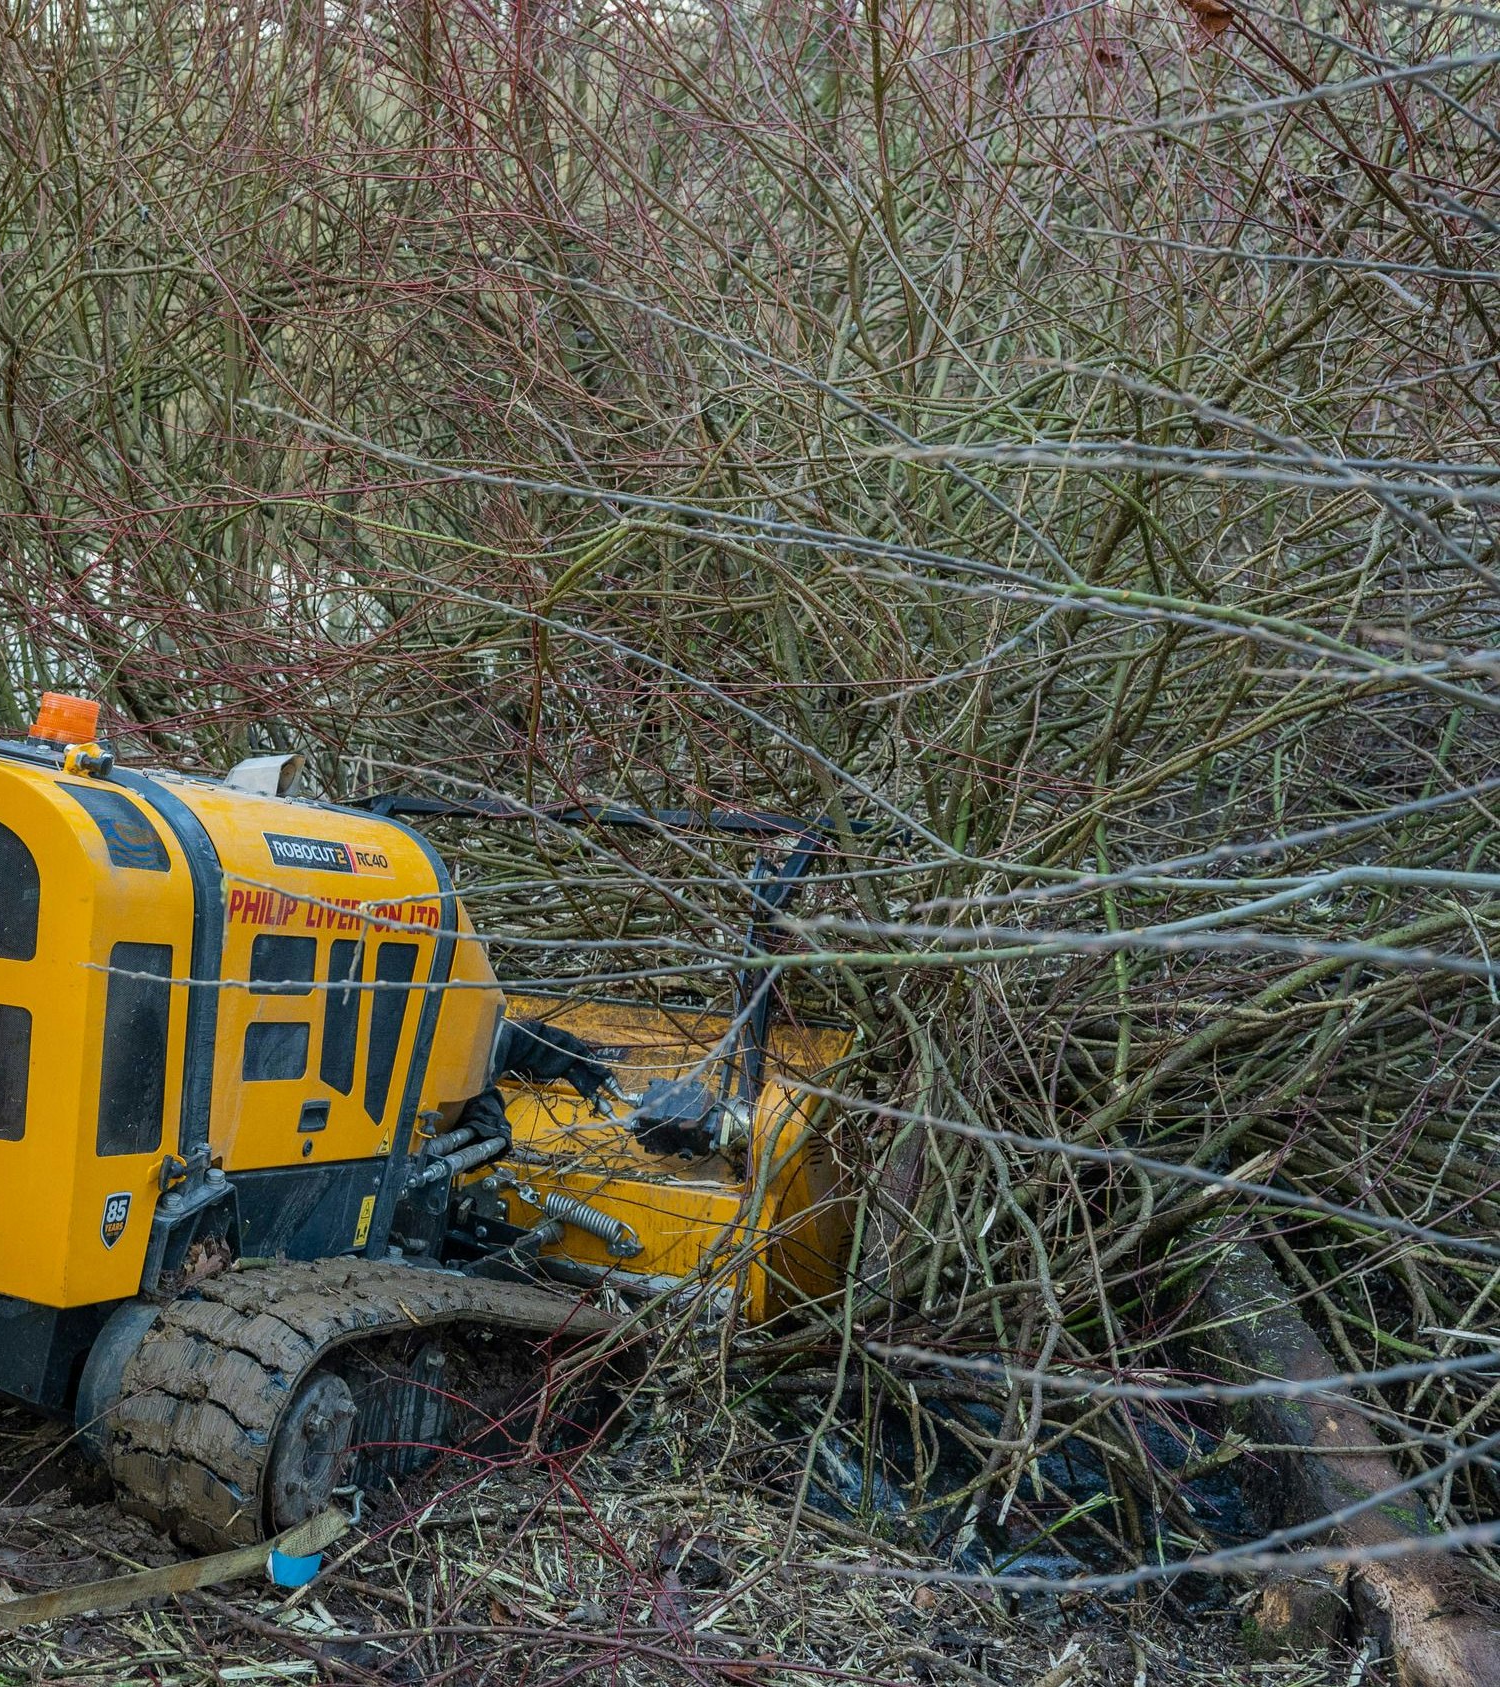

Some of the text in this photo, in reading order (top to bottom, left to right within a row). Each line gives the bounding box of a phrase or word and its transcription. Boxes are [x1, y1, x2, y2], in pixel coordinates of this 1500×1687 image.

[355, 851, 389, 869] RC40
[227, 889, 440, 936] PHILIP LIVERON LTD
[106, 1200, 127, 1222] 85
